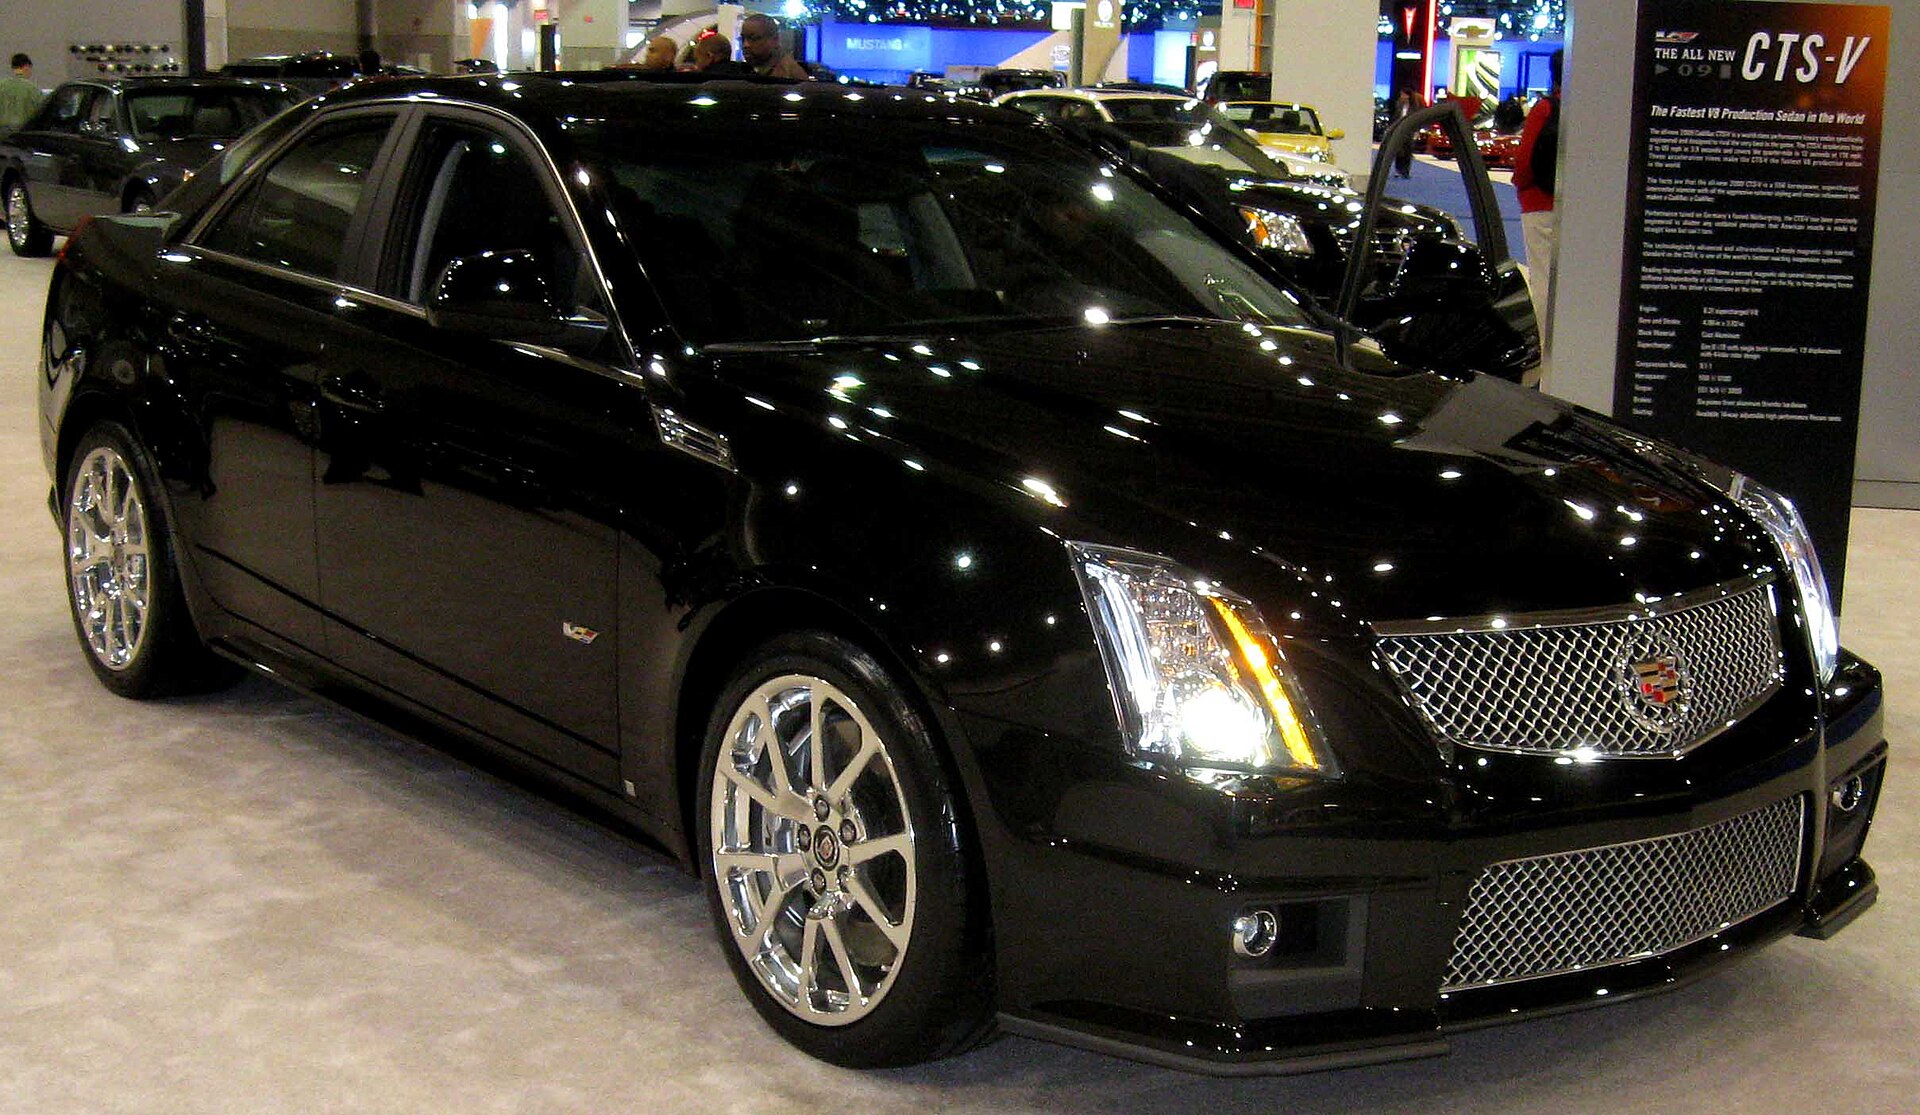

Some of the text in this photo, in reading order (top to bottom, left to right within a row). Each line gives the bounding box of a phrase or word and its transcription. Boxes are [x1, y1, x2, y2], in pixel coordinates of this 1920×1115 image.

[1654, 47, 1736, 62] THE ALL NEW
[1741, 32, 1872, 84] CTS-V
[1651, 105, 1668, 117] The
[1669, 106, 1706, 119] Fastest
[1721, 108, 1774, 121] Production
[1775, 110, 1806, 123] Sedan
[1806, 111, 1817, 123] in
[1818, 111, 1835, 124] the
[1836, 112, 1866, 125] World
